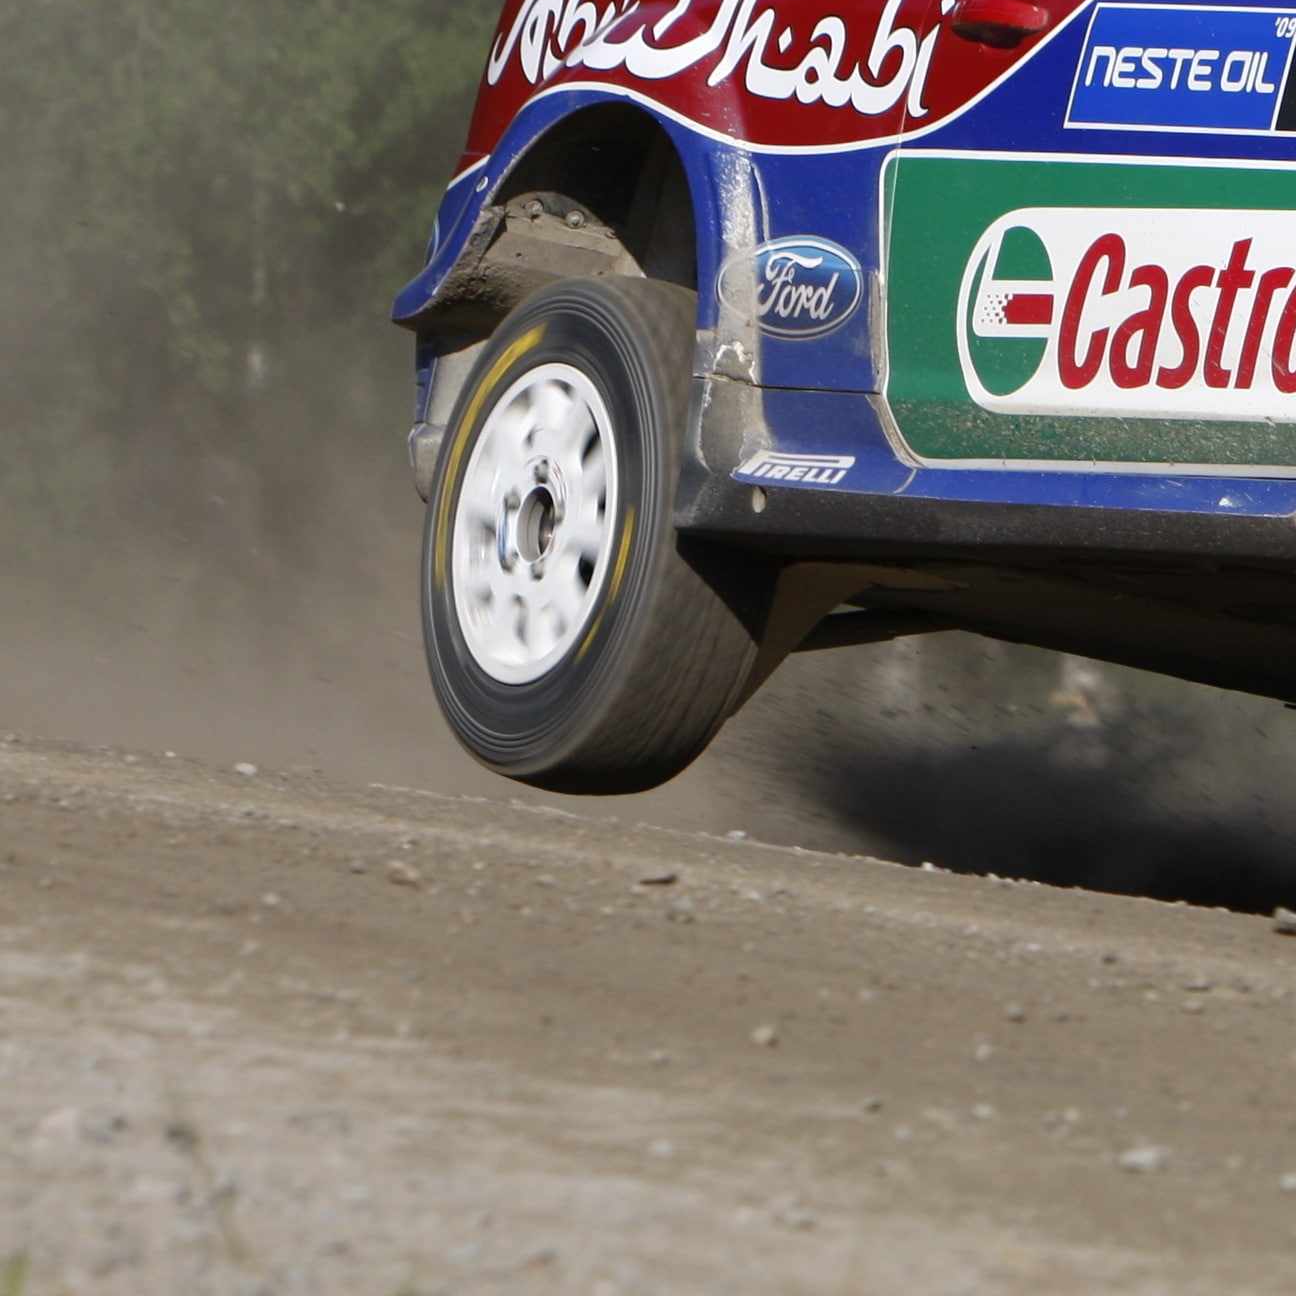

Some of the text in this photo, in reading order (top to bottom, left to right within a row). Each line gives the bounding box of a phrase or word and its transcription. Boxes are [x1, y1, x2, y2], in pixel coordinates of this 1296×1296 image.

[1084, 46, 1276, 94] NESTE OIL
[757, 252, 840, 320] Ford
[738, 448, 856, 485] PIRELLI
